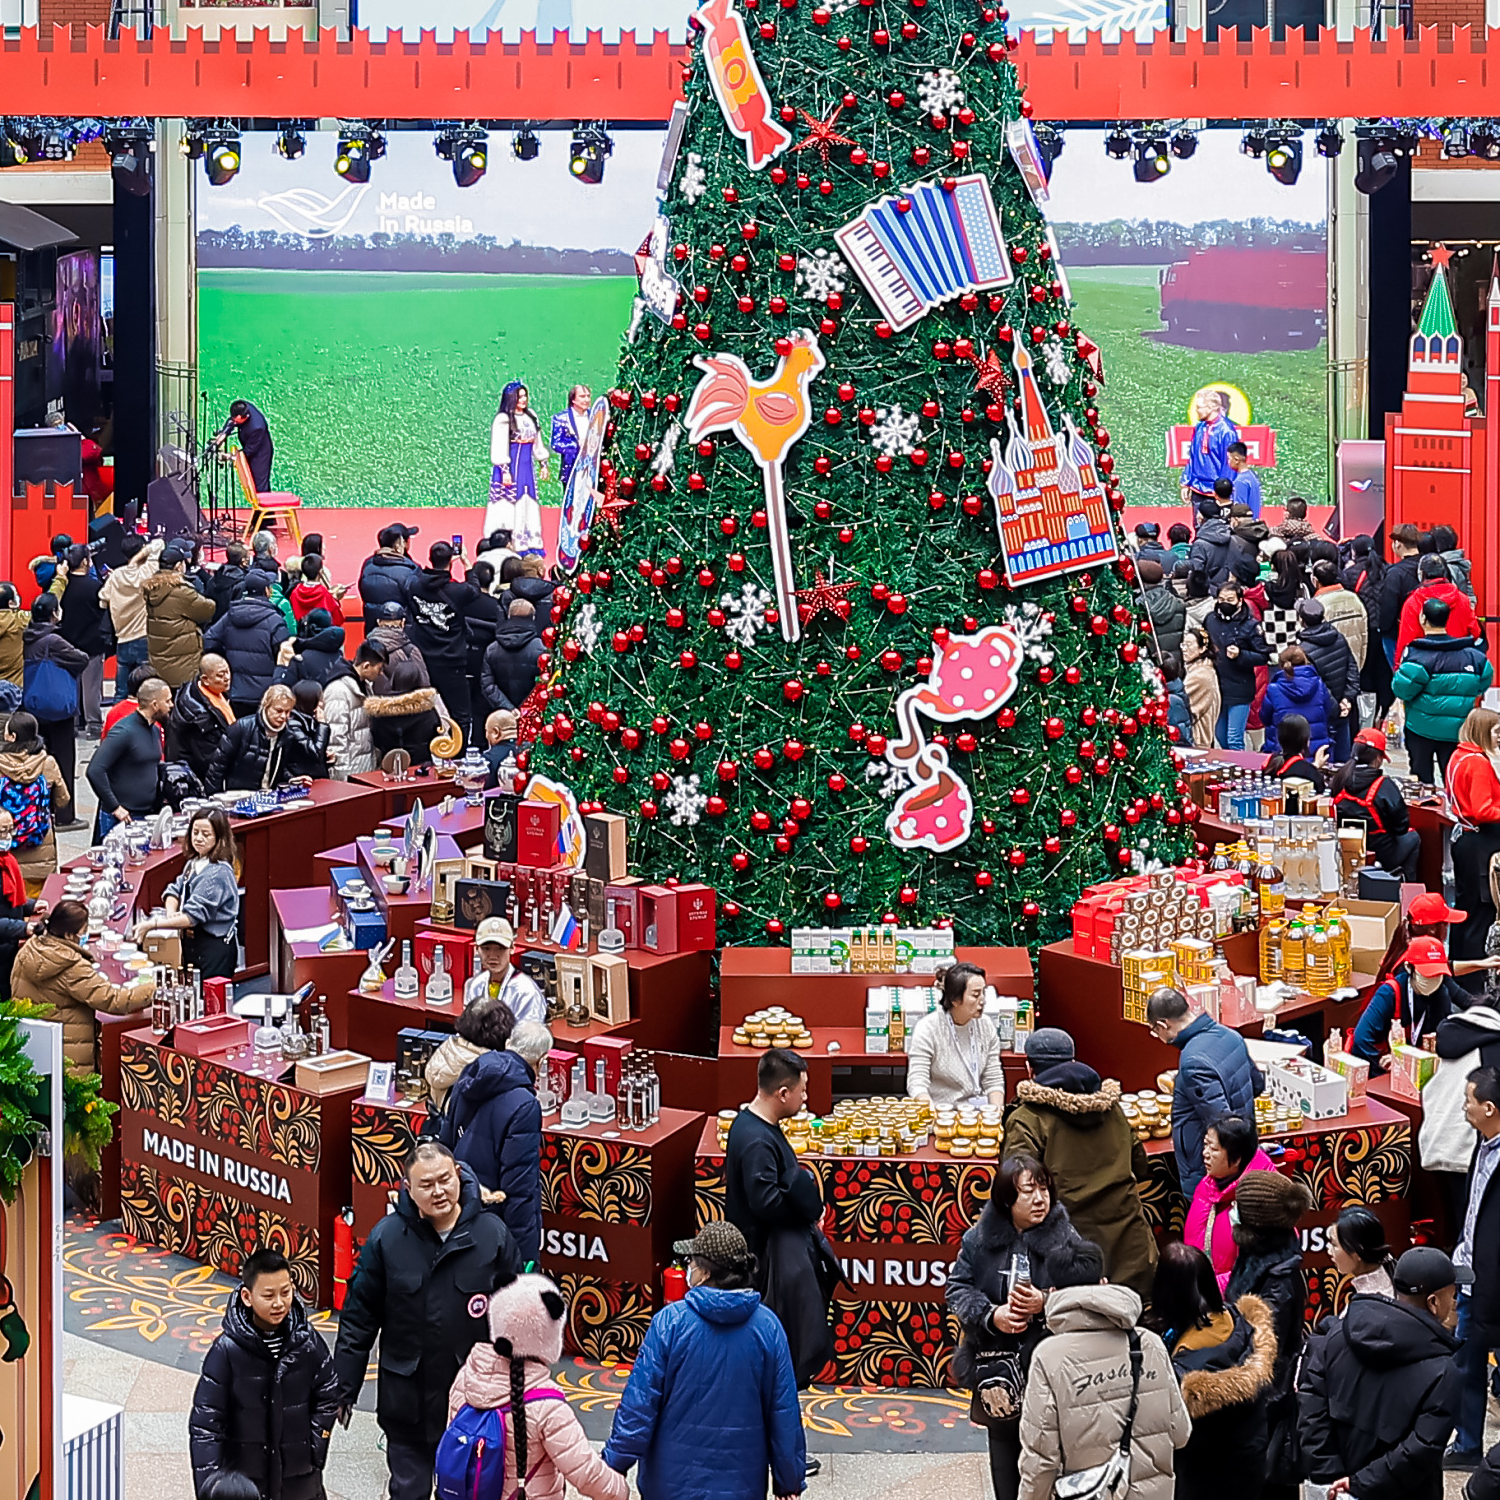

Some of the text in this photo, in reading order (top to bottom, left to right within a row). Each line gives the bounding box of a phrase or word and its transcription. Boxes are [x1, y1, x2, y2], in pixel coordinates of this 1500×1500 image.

[380, 191, 436, 210] Made
[380, 214, 474, 233] in Russia
[143, 1128, 292, 1204] MADE IN RUSSIA
[539, 1228, 609, 1263] SSIA
